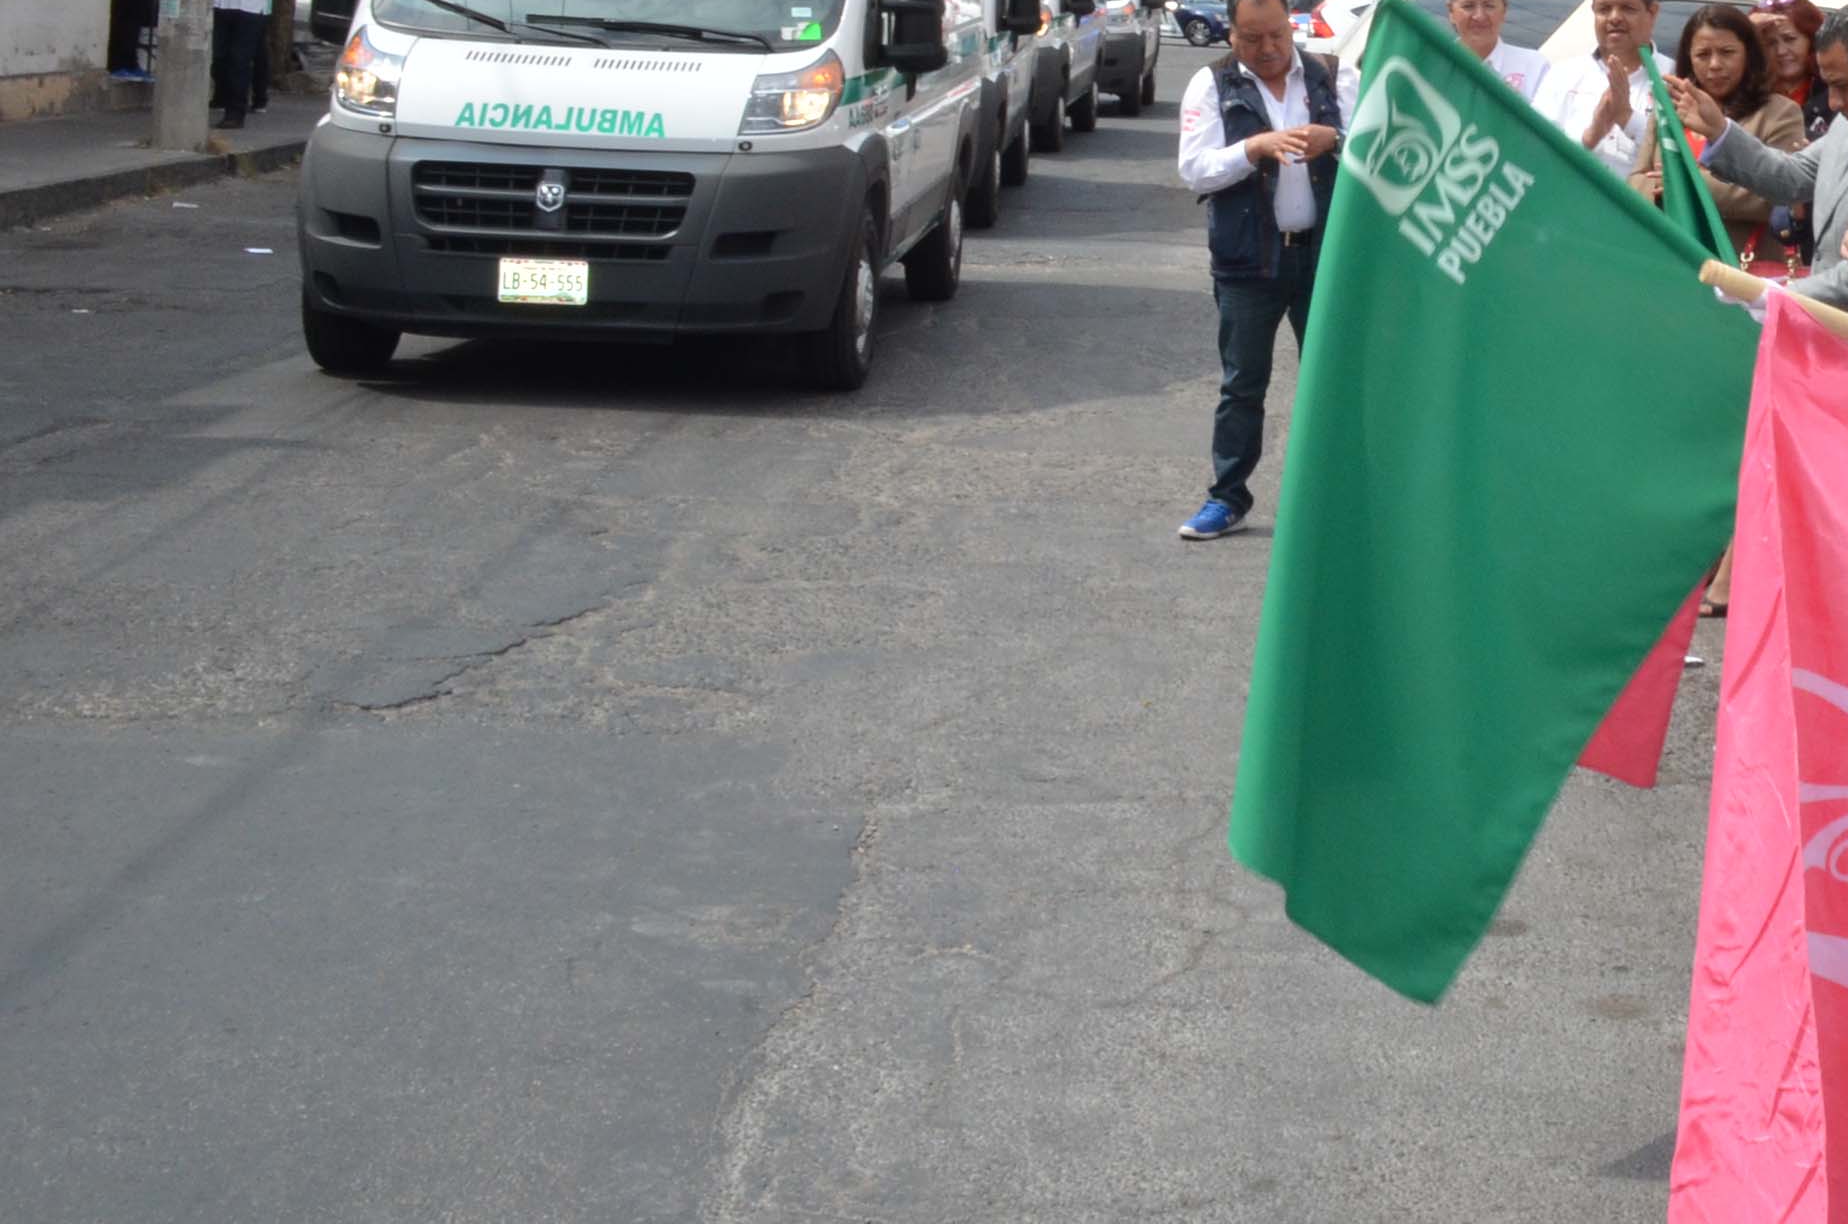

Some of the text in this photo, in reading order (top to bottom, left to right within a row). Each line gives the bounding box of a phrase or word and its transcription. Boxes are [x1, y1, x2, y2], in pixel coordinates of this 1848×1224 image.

[1398, 123, 1499, 257] IMSS
[1437, 160, 1536, 285] PUEBLA
[502, 271, 584, 293] LB-54-555
